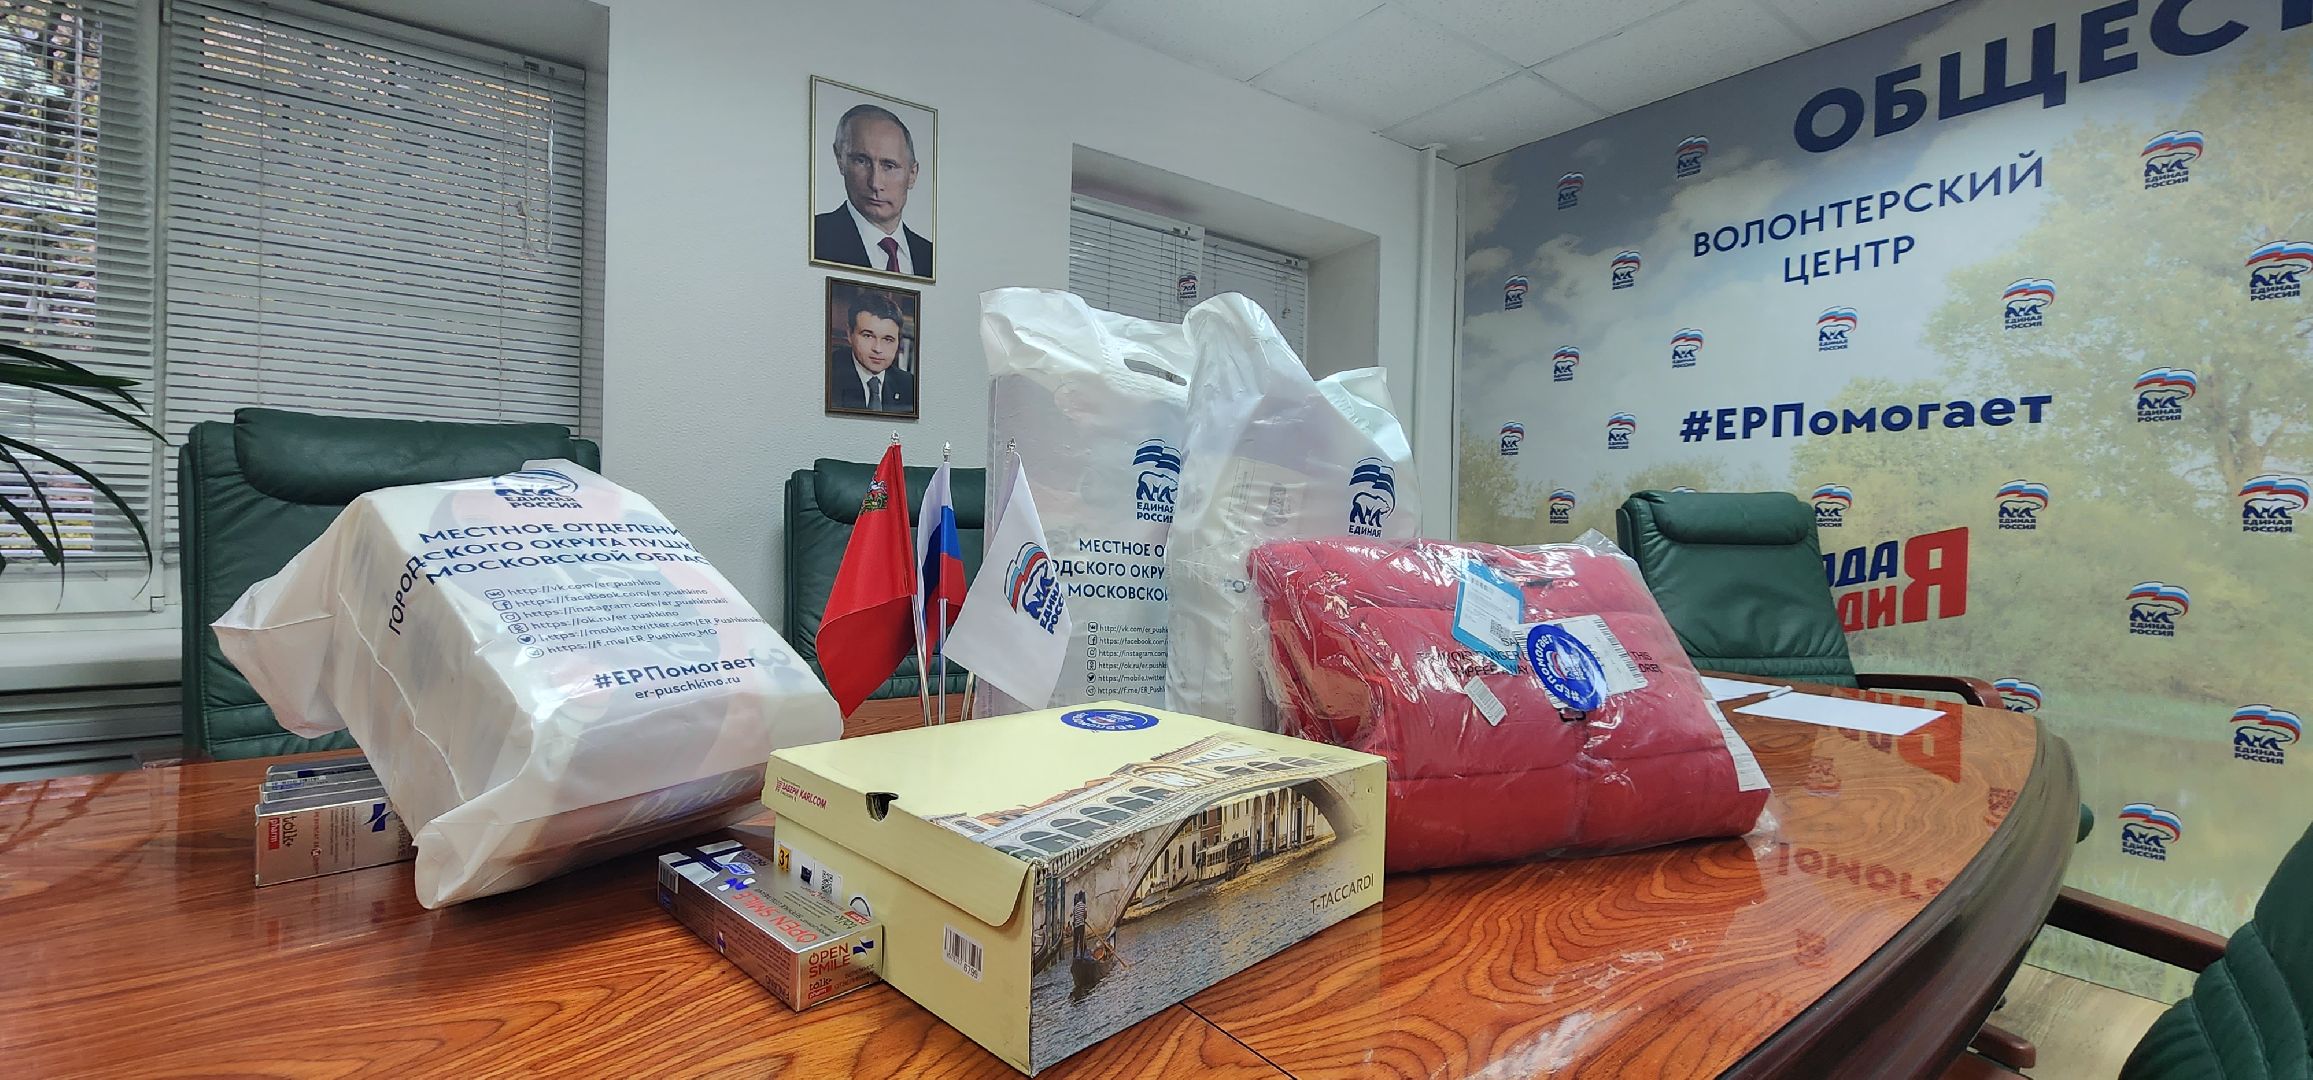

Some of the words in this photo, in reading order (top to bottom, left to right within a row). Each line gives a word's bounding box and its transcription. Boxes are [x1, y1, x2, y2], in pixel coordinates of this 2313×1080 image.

[1794, 0, 2313, 153] ОБЩЕС
[1693, 150, 2043, 257] ВОЛОНТЕРСКИЙ
[1784, 235, 1915, 285] ЦЕНТР
[2250, 290, 2300, 302] РОССИЯ
[1681, 395, 2053, 443] #ЕРПомогает
[510, 501, 583, 509] РОССИЯ
[419, 523, 559, 544] МЕСТНОЕ
[562, 522, 685, 538] ОТДЕЛЕНИ
[1348, 524, 1383, 538] ЕДИНАЯ
[1079, 538, 1151, 557] МЕСТНОЕ
[1154, 544, 1166, 558] О
[425, 550, 632, 586] МОСКОВСКОЙ
[635, 552, 710, 566] ОБЛАС
[1130, 564, 1165, 579] ОКРУ
[388, 541, 524, 636] ГОРОДСКОГО
[530, 537, 627, 551] ОКРУГА
[627, 537, 700, 553] ПУШК
[1040, 582, 1060, 629] ЕДИНА
[1047, 592, 1065, 634] РОСС
[2129, 622, 2175, 631] ЕДИНАЯ
[2129, 629, 2175, 637] РОССИЯ
[592, 658, 757, 689] #ЕРПомогает
[634, 676, 741, 700] er-puschkino.ru
[2234, 745, 2285, 758] ЕДИНАЯ
[2234, 752, 2285, 765] РОССИЯ
[779, 848, 790, 870] 31
[2122, 841, 2166, 854] ЕДИНАЯ
[2122, 848, 2166, 861] РОССИЯ
[1310, 872, 1375, 915] T-TACCARDI
[772, 914, 819, 943] OPEN
[808, 942, 849, 966] OPEN
[808, 953, 851, 979] SMILE
